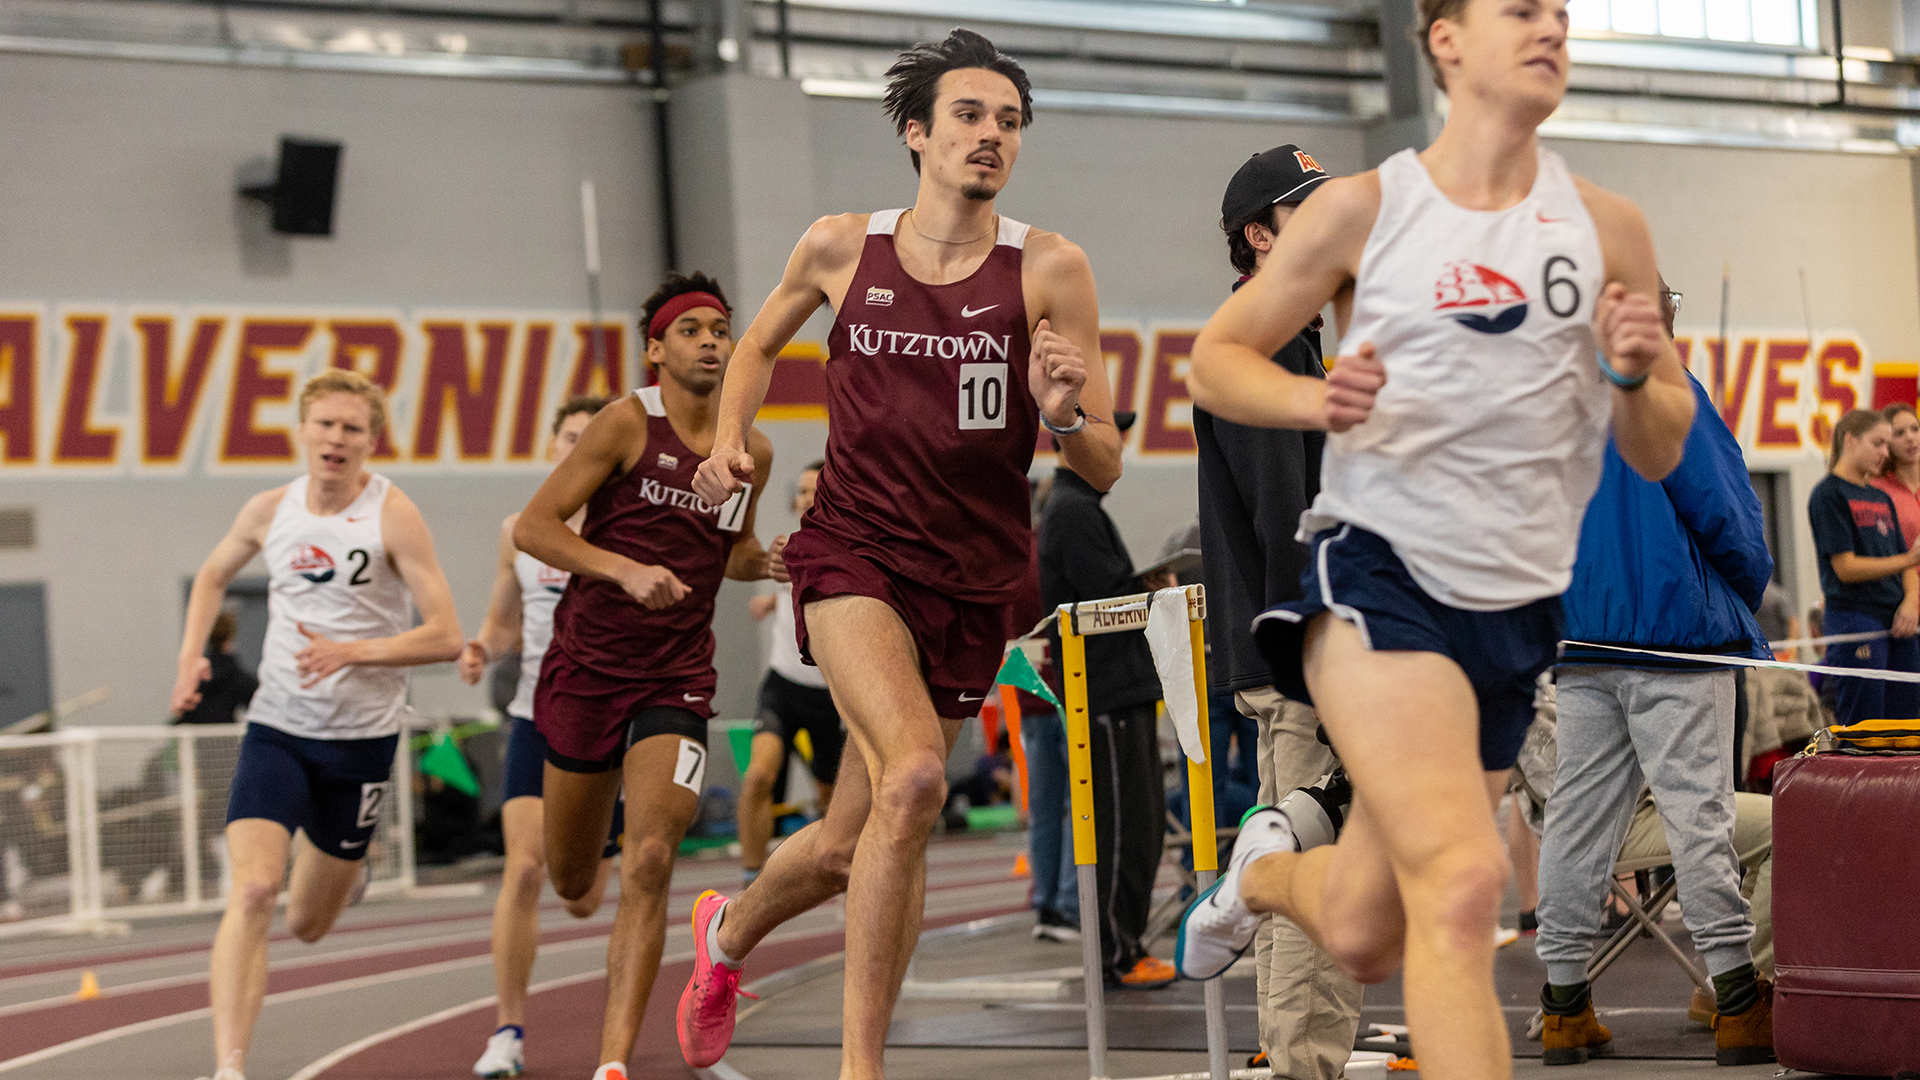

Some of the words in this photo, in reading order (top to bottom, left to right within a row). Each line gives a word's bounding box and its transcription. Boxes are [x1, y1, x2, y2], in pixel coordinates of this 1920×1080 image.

[867, 292, 893, 301] PSAC
[1544, 255, 1581, 319] 6
[849, 324, 1011, 361] KUTZTOWN
[961, 376, 1002, 421] 10
[638, 477, 721, 516] KUTZTO
[347, 548, 372, 586] 2
[1093, 602, 1149, 628] ALVERNI
[686, 744, 702, 784] 7
[362, 788, 383, 821] 2
